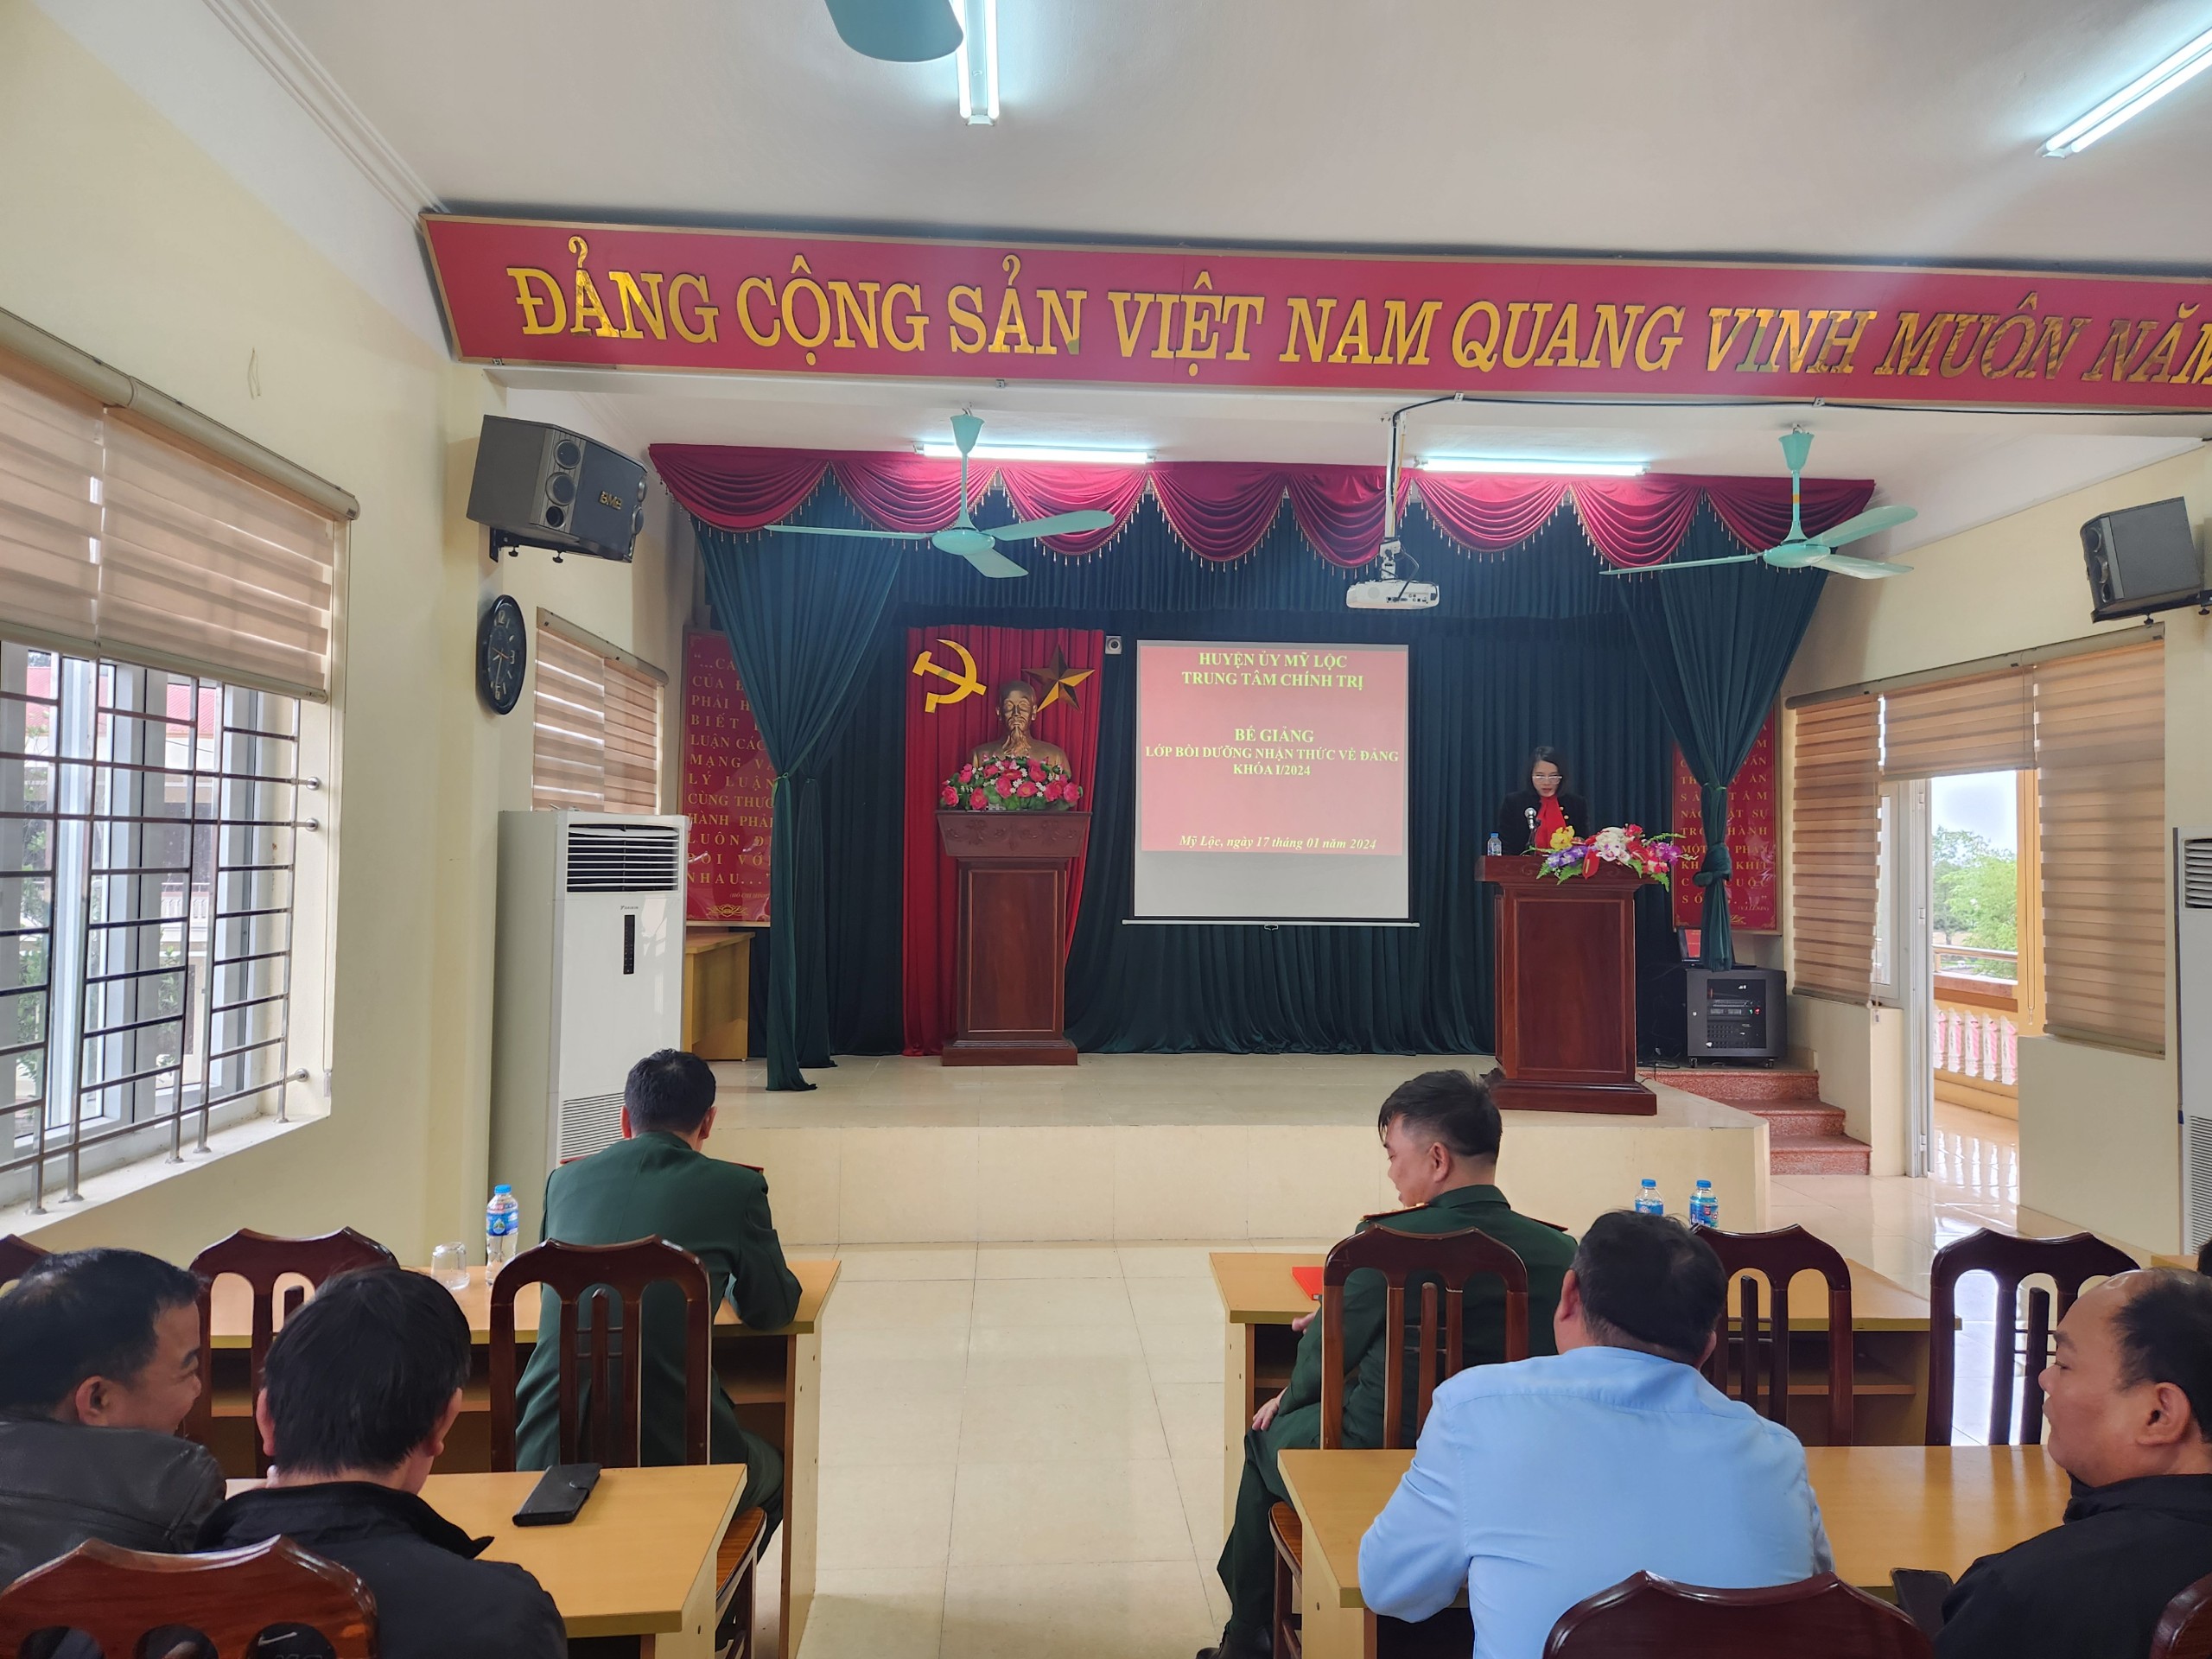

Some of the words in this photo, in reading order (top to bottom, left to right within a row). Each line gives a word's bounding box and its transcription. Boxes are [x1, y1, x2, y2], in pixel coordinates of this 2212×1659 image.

[505, 235, 719, 344] ĐẢNG
[736, 254, 929, 366] CỘNG
[947, 254, 1087, 356] SẢN
[1108, 270, 1265, 378] VIỆT
[1279, 297, 1442, 365] NAM
[1452, 300, 1686, 372] QUANG
[1707, 307, 1878, 375] VINH
[1872, 291, 2094, 381] MUÔN
[1198, 652, 1255, 669] HUYỆN
[1258, 650, 1281, 667] ỦY
[1284, 652, 1310, 668] MỸ
[1313, 652, 1348, 671] LỘC
[1181, 671, 1237, 685] TRUNG
[1241, 669, 1276, 686] TÂM
[1280, 671, 1332, 688] CHÍNH
[1336, 674, 1363, 691] TRỊ
[690, 713, 740, 729] BIẾT
[690, 733, 730, 750] LUẬN
[1234, 725, 1256, 742] BẾ
[1260, 725, 1314, 743] GIẢNG
[690, 753, 741, 768] MẠNG
[1145, 743, 1173, 758] LỚP
[1202, 745, 1253, 759] DƯỠNG
[1296, 747, 1336, 760] THỨC
[1360, 747, 1399, 762] ĐẢNG
[1233, 761, 1274, 775] KHÓA
[1275, 764, 1311, 776] I/2024
[689, 771, 712, 785] LÝ
[688, 790, 729, 806] CÙNG
[1179, 835, 1198, 849] Mỹ
[1226, 836, 1254, 849] ngày
[1256, 836, 1269, 847] 17
[1271, 836, 1303, 850] tháng
[1306, 837, 1320, 849] 01
[1322, 838, 1346, 849] năm
[1350, 838, 1377, 850] 2024
